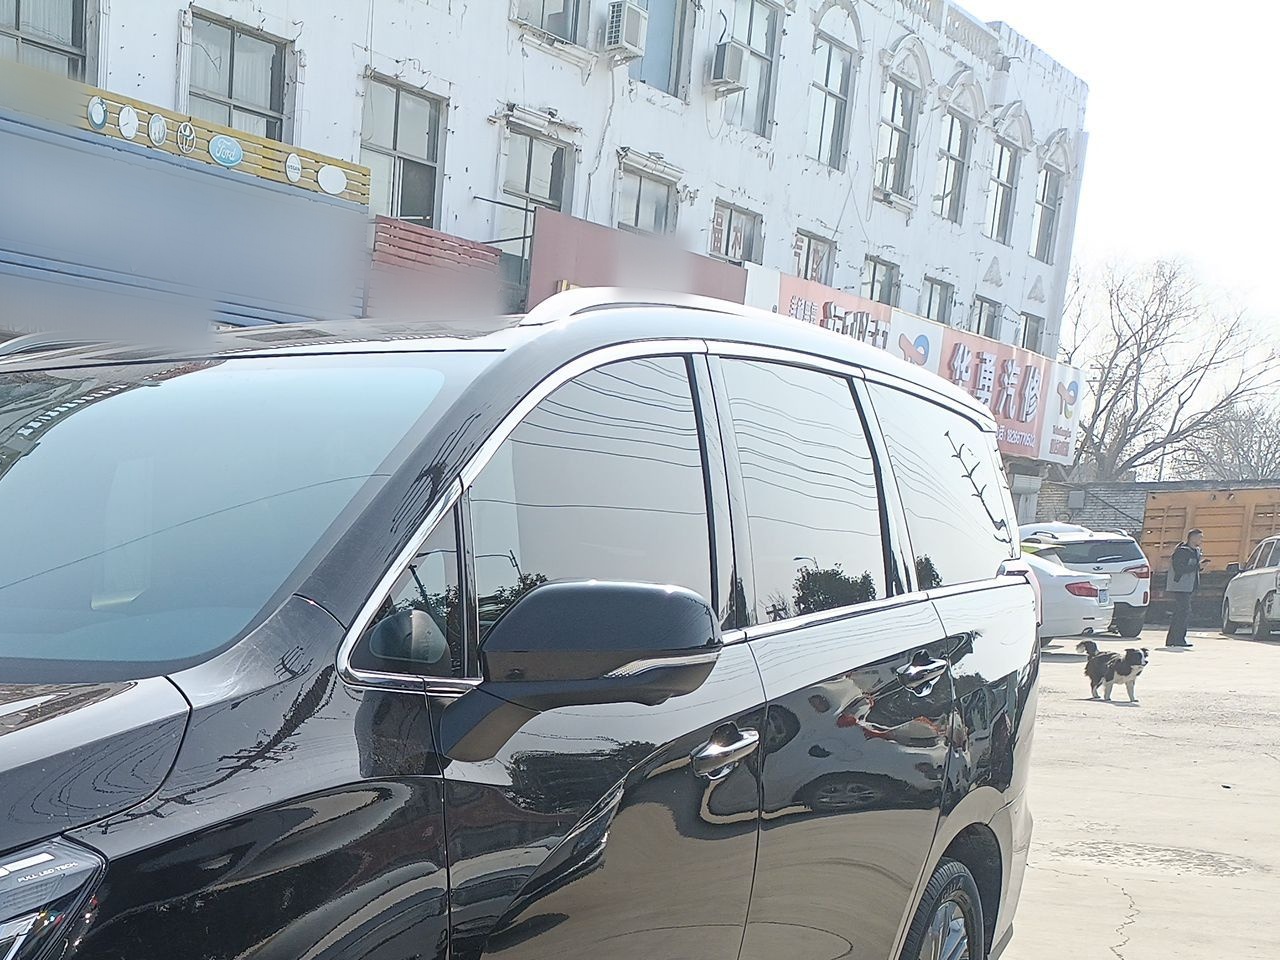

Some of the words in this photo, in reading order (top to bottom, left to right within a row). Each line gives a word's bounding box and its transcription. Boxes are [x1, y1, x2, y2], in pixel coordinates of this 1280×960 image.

[949, 342, 1041, 424] 华勇汽修
[18, 874, 38, 882] FULL
[39, 868, 55, 877] LED
